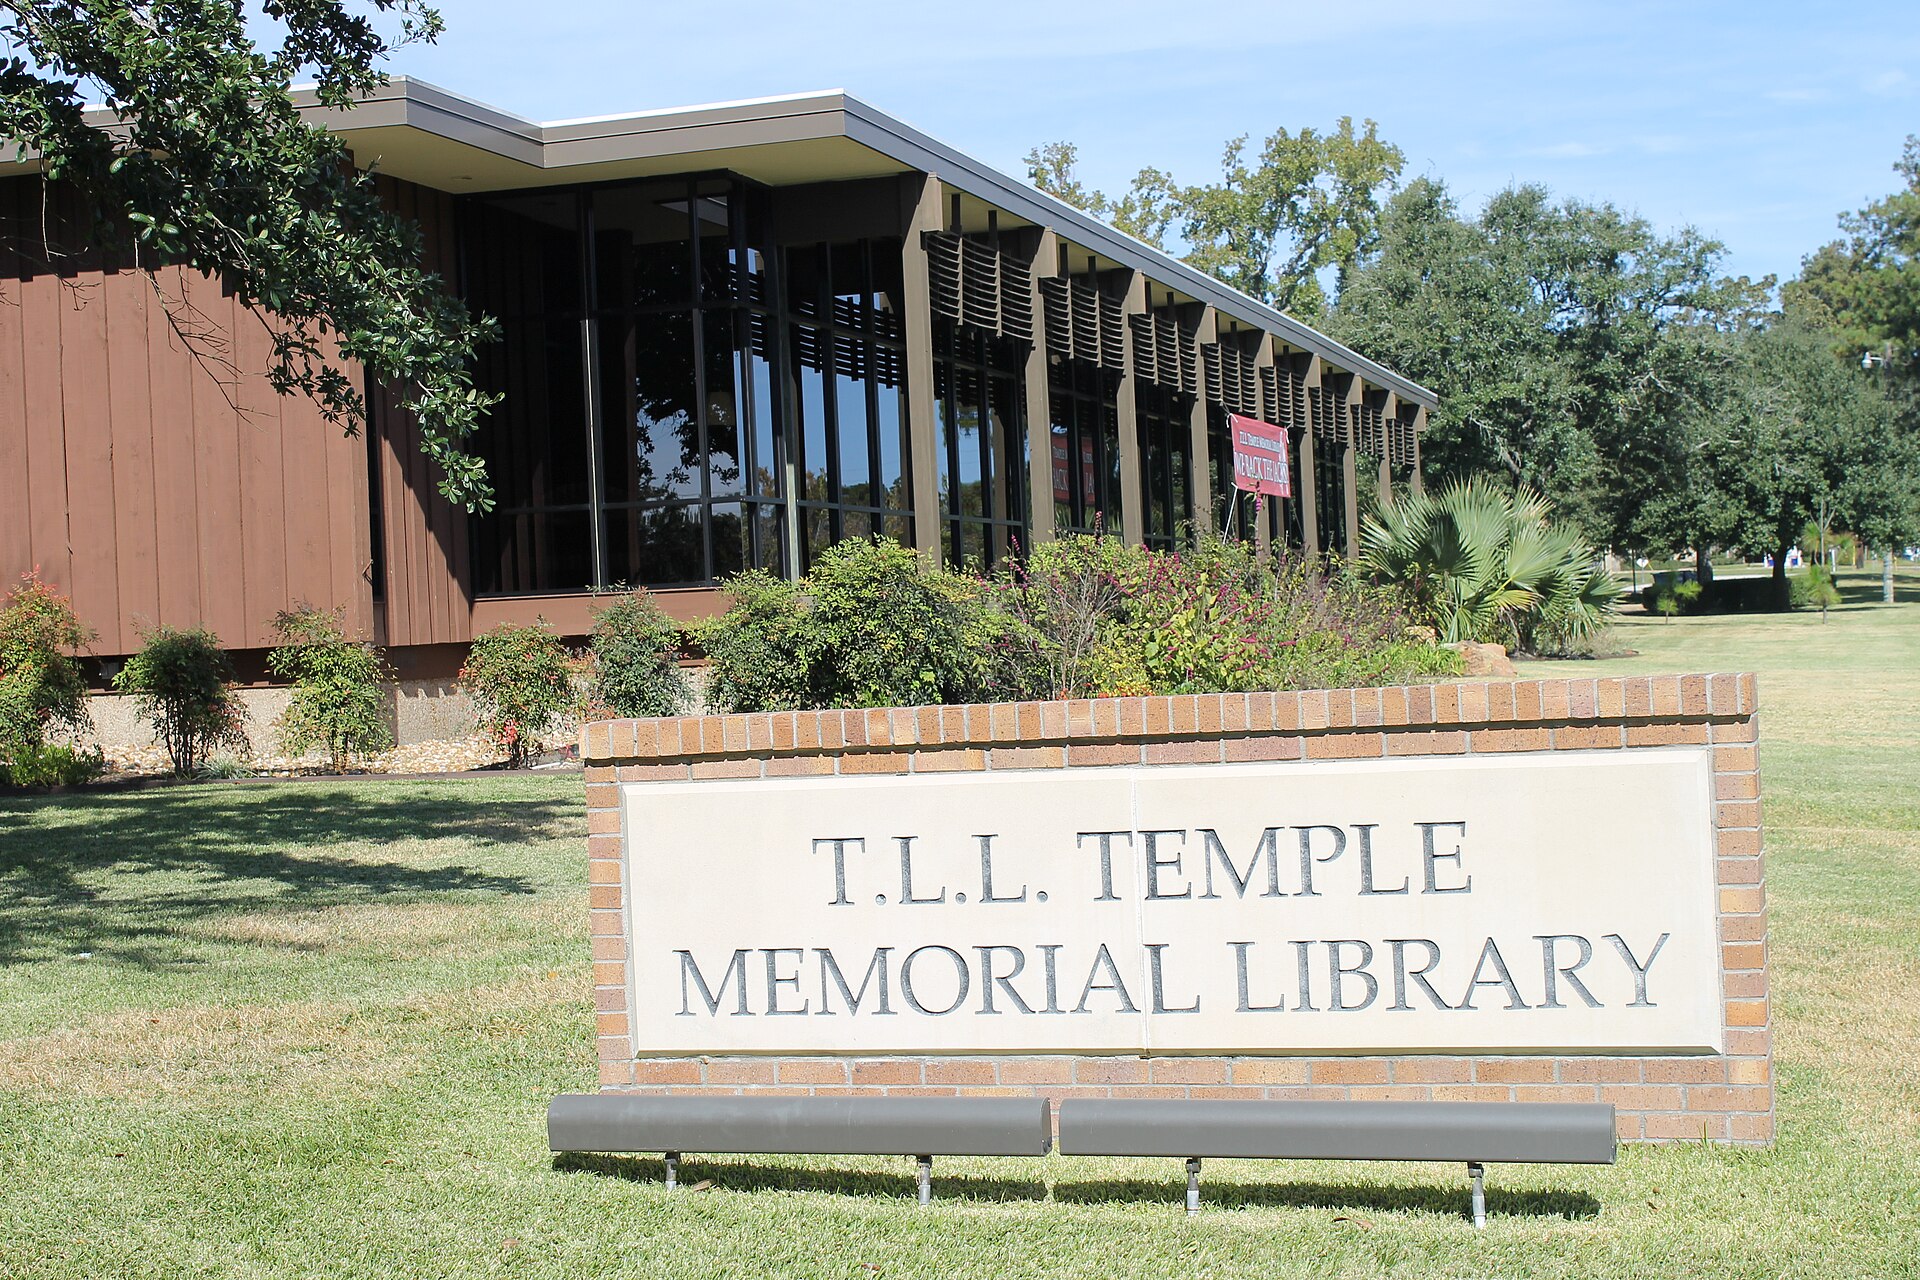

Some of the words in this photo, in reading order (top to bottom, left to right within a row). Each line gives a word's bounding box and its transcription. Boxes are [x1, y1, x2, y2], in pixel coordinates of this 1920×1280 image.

[812, 834, 1049, 906] T.L.L.
[1076, 821, 1472, 900] TEMPLE
[672, 943, 1201, 1017] MEMORIAL
[1226, 932, 1671, 1012] LIBRARY
